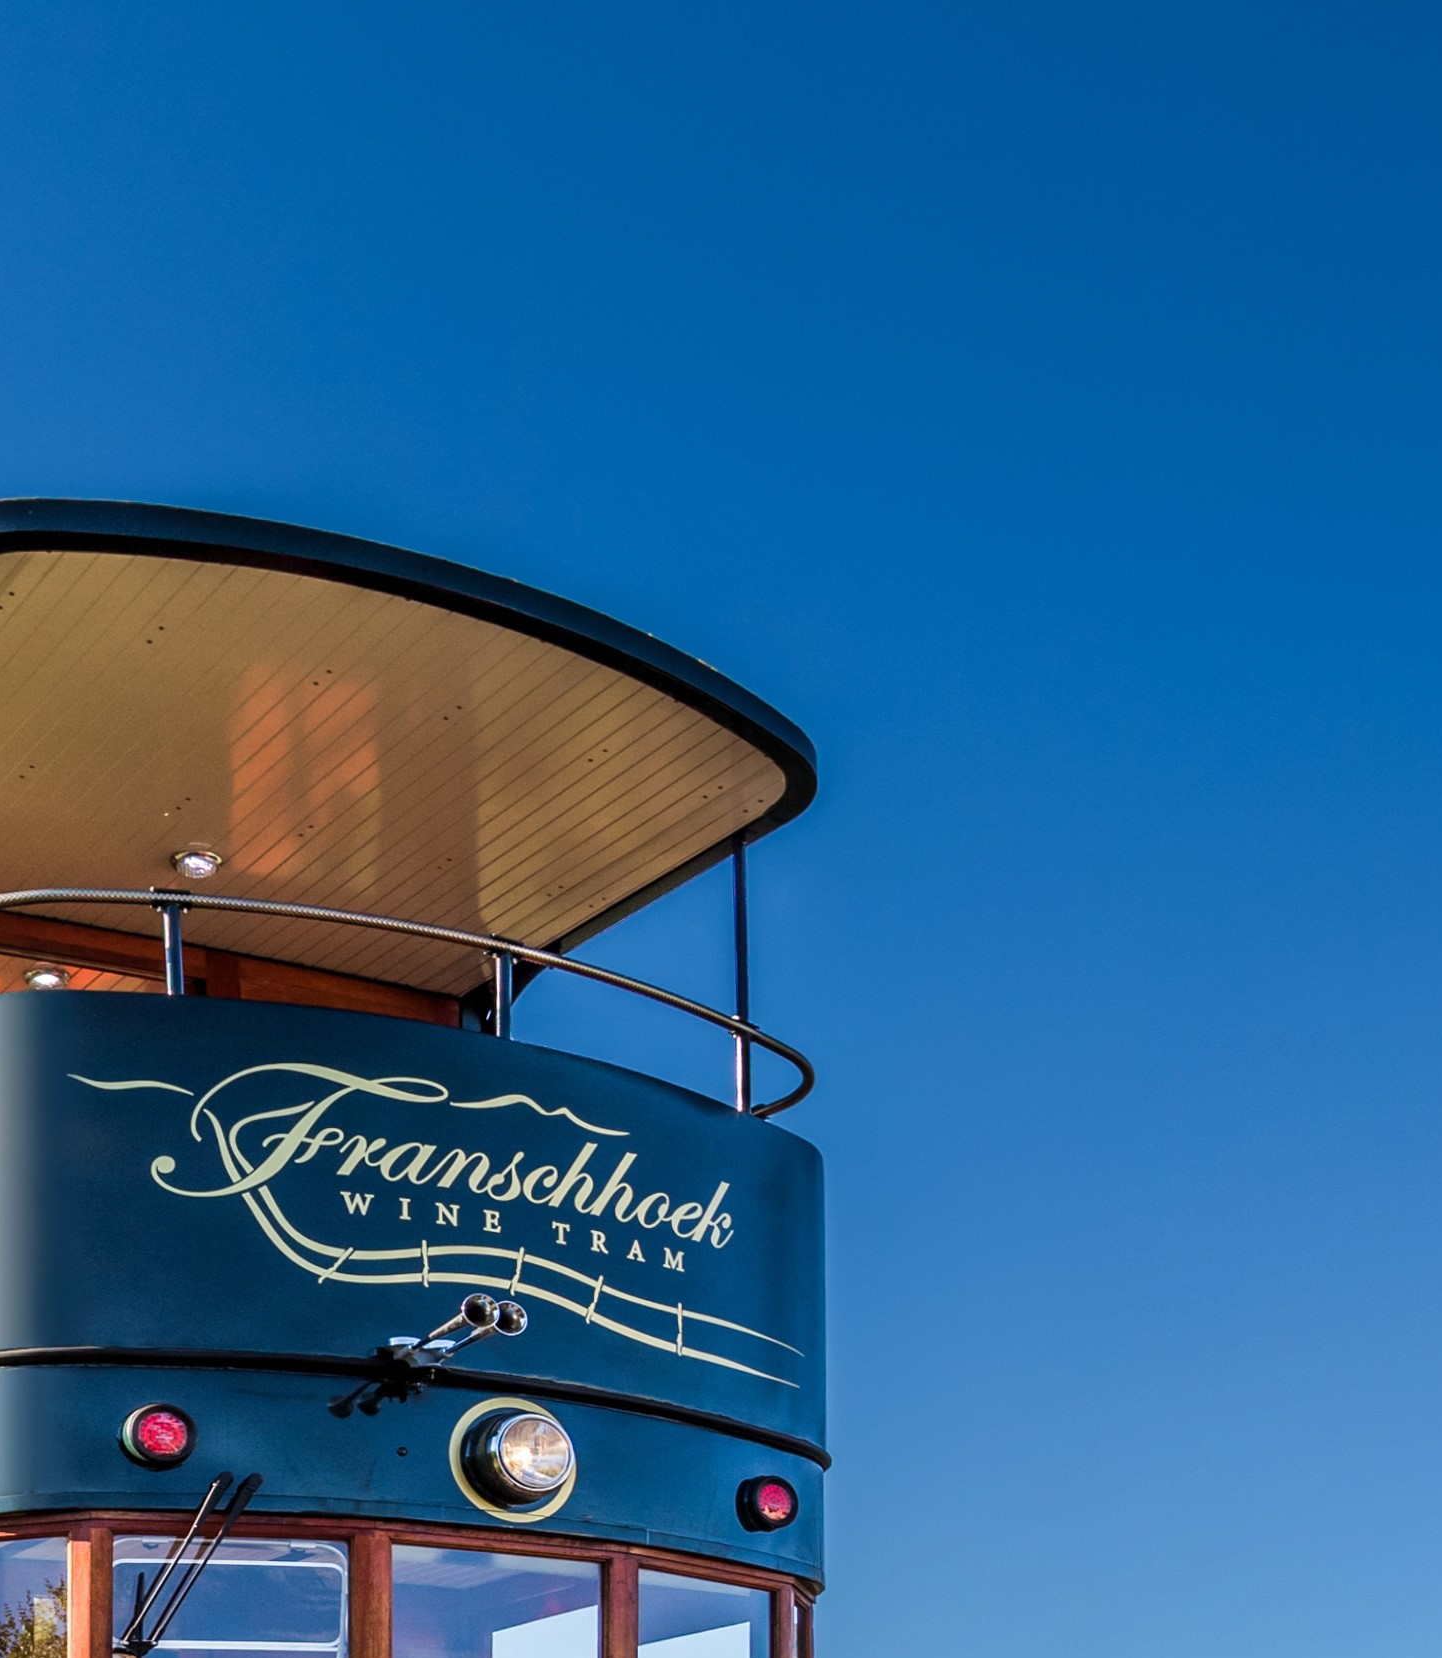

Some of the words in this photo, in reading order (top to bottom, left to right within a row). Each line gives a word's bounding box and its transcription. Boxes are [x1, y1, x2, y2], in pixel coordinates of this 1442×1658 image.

[151, 1063, 734, 1249] Franschhoek
[340, 1191, 502, 1233] WINE
[552, 1221, 685, 1272] TRAM
